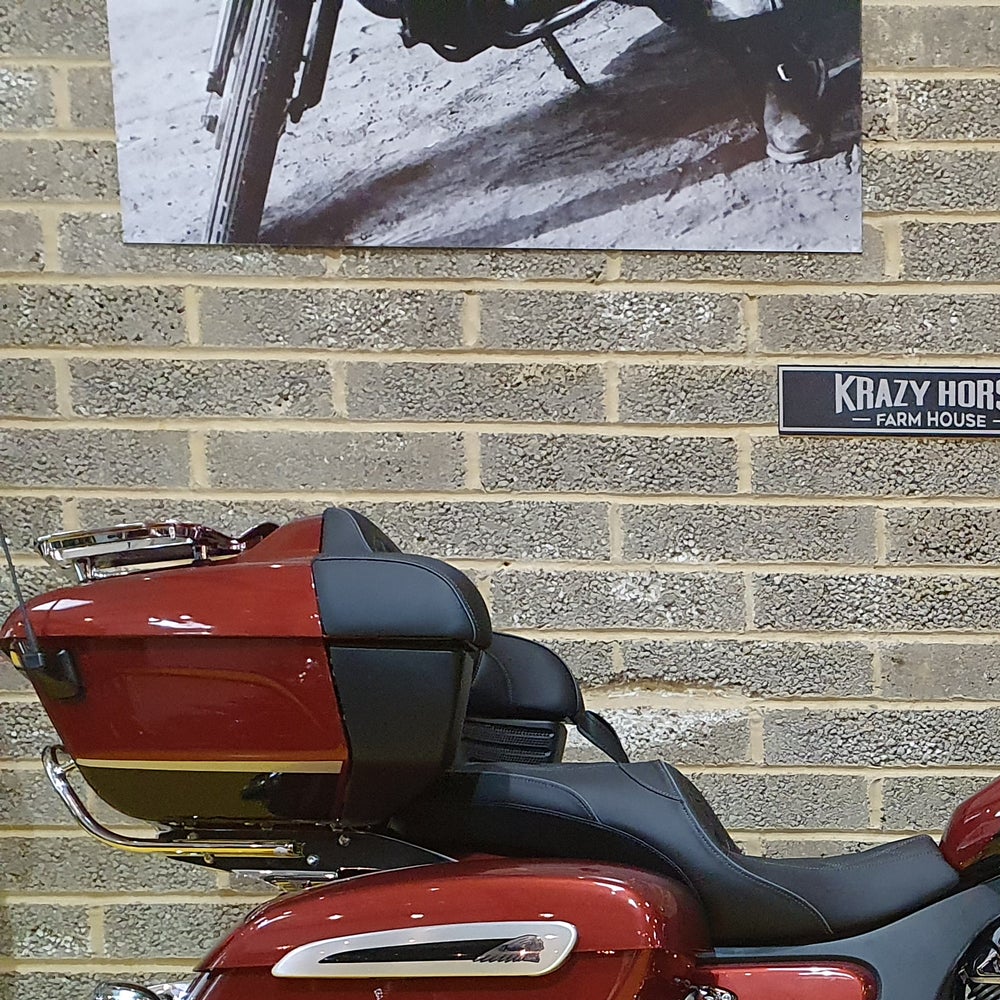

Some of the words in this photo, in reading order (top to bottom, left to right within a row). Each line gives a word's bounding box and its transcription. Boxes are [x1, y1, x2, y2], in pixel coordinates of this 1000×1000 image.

[834, 373, 930, 414] KRAZY
[876, 412, 921, 427] FARM
[926, 411, 987, 428] HOUSE
